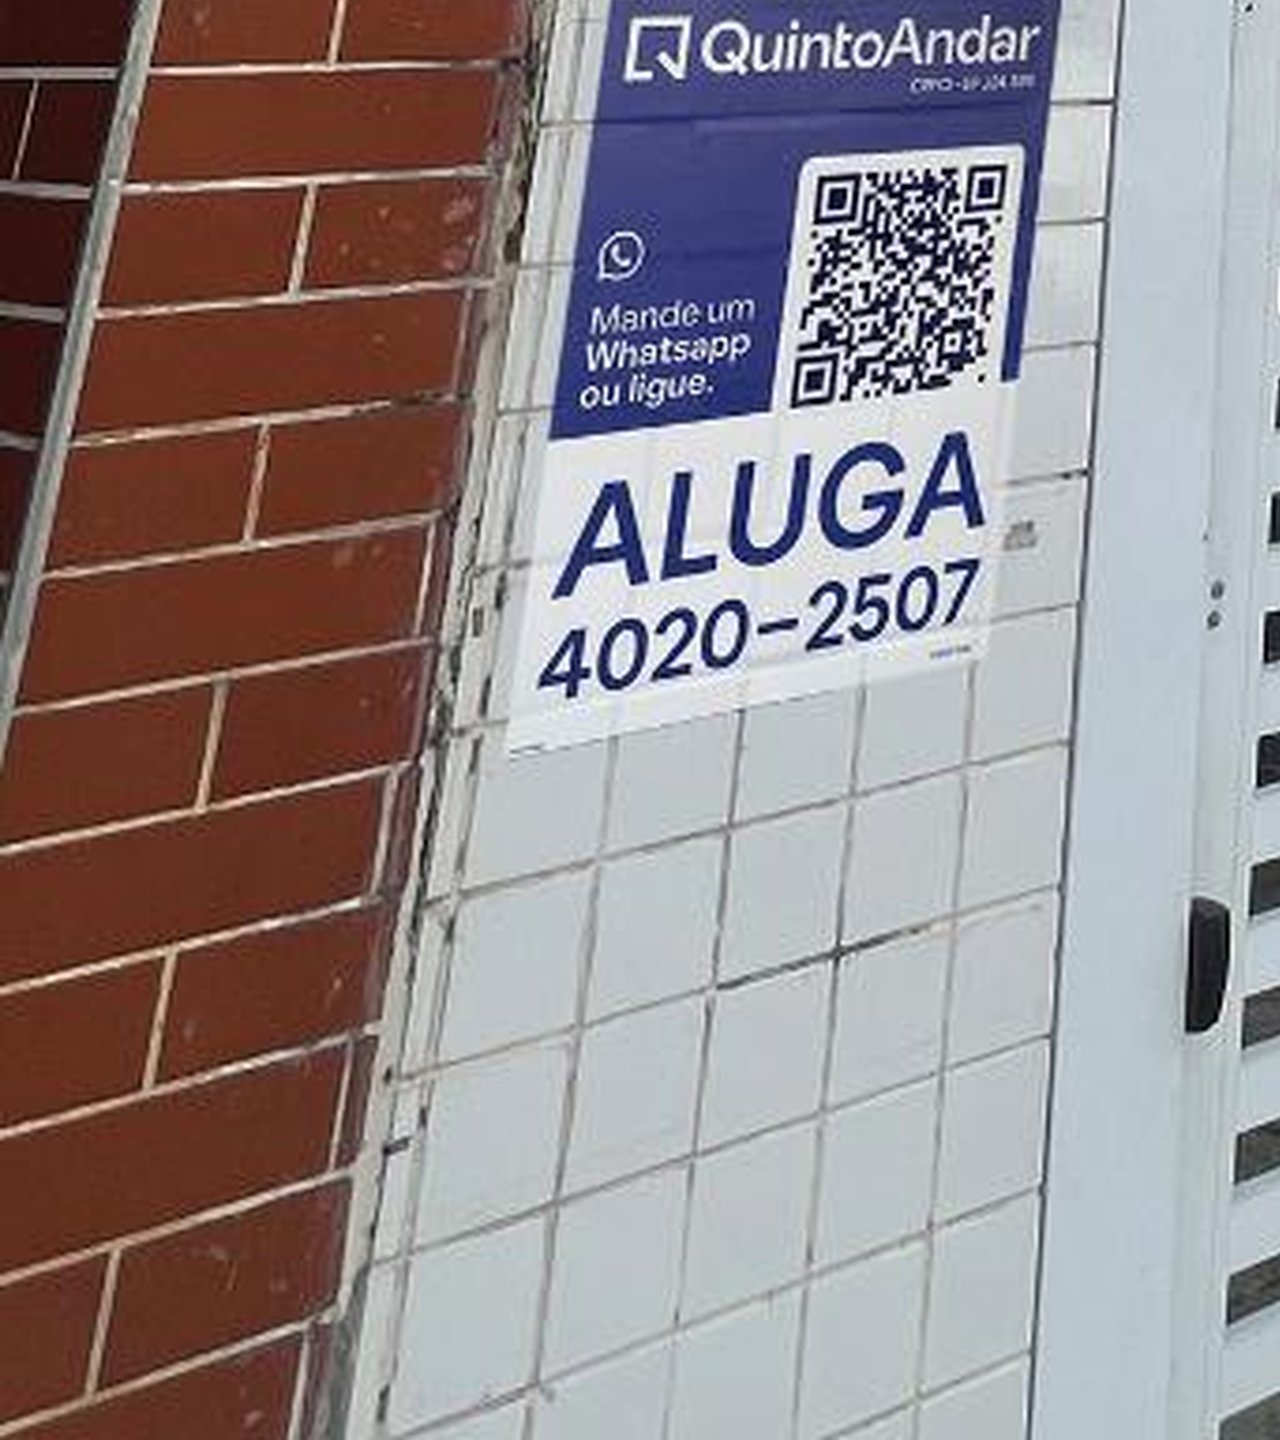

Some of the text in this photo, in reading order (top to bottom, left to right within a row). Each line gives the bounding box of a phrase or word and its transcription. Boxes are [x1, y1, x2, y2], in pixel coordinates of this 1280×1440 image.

[700, 14, 1040, 75] QuintoAndar
[590, 298, 755, 335] Mande um
[586, 333, 751, 371] Whatsapp
[580, 372, 714, 409] ou ligue.
[551, 431, 986, 600] ALUGA
[536, 558, 981, 699] 4020-2507
